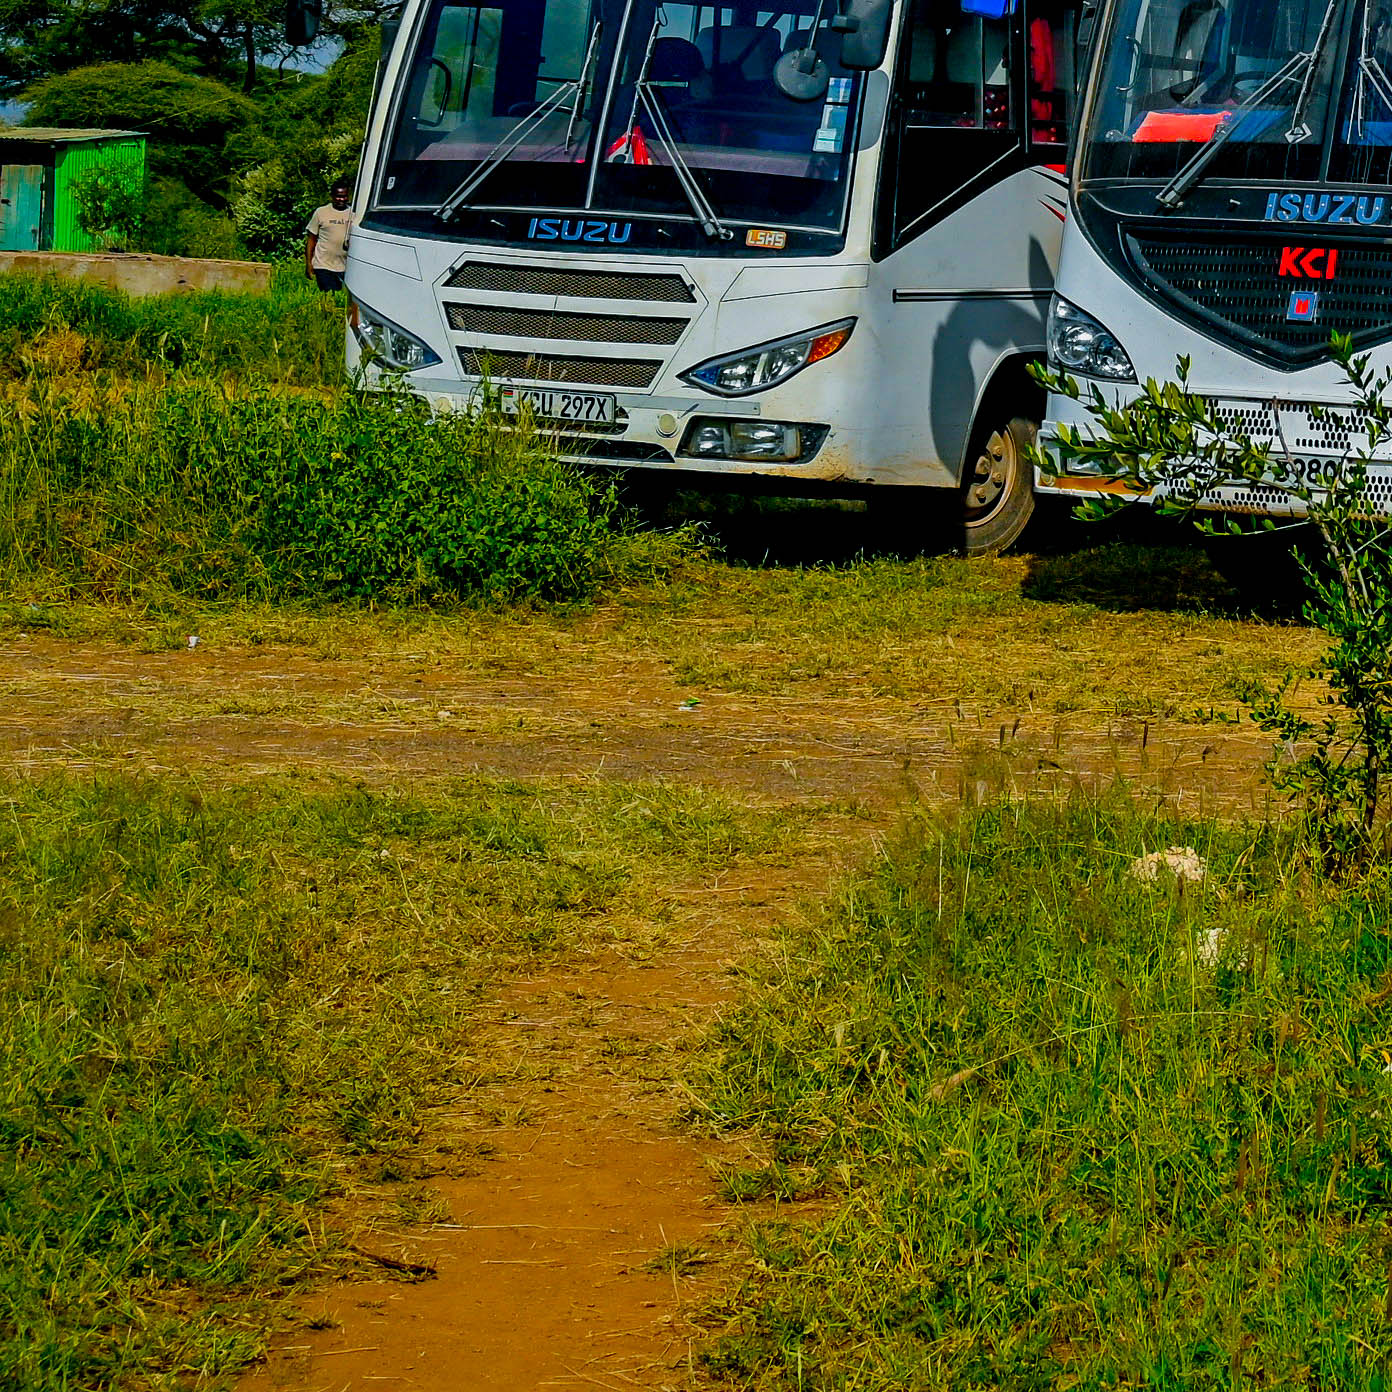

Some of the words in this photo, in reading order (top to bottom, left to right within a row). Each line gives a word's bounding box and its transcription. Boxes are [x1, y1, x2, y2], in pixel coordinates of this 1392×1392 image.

[1264, 192, 1385, 225] ISUZU
[527, 218, 632, 243] ISUZU
[747, 232, 785, 247] LSHS
[1278, 246, 1339, 280] KCI
[560, 394, 607, 421] 297X
